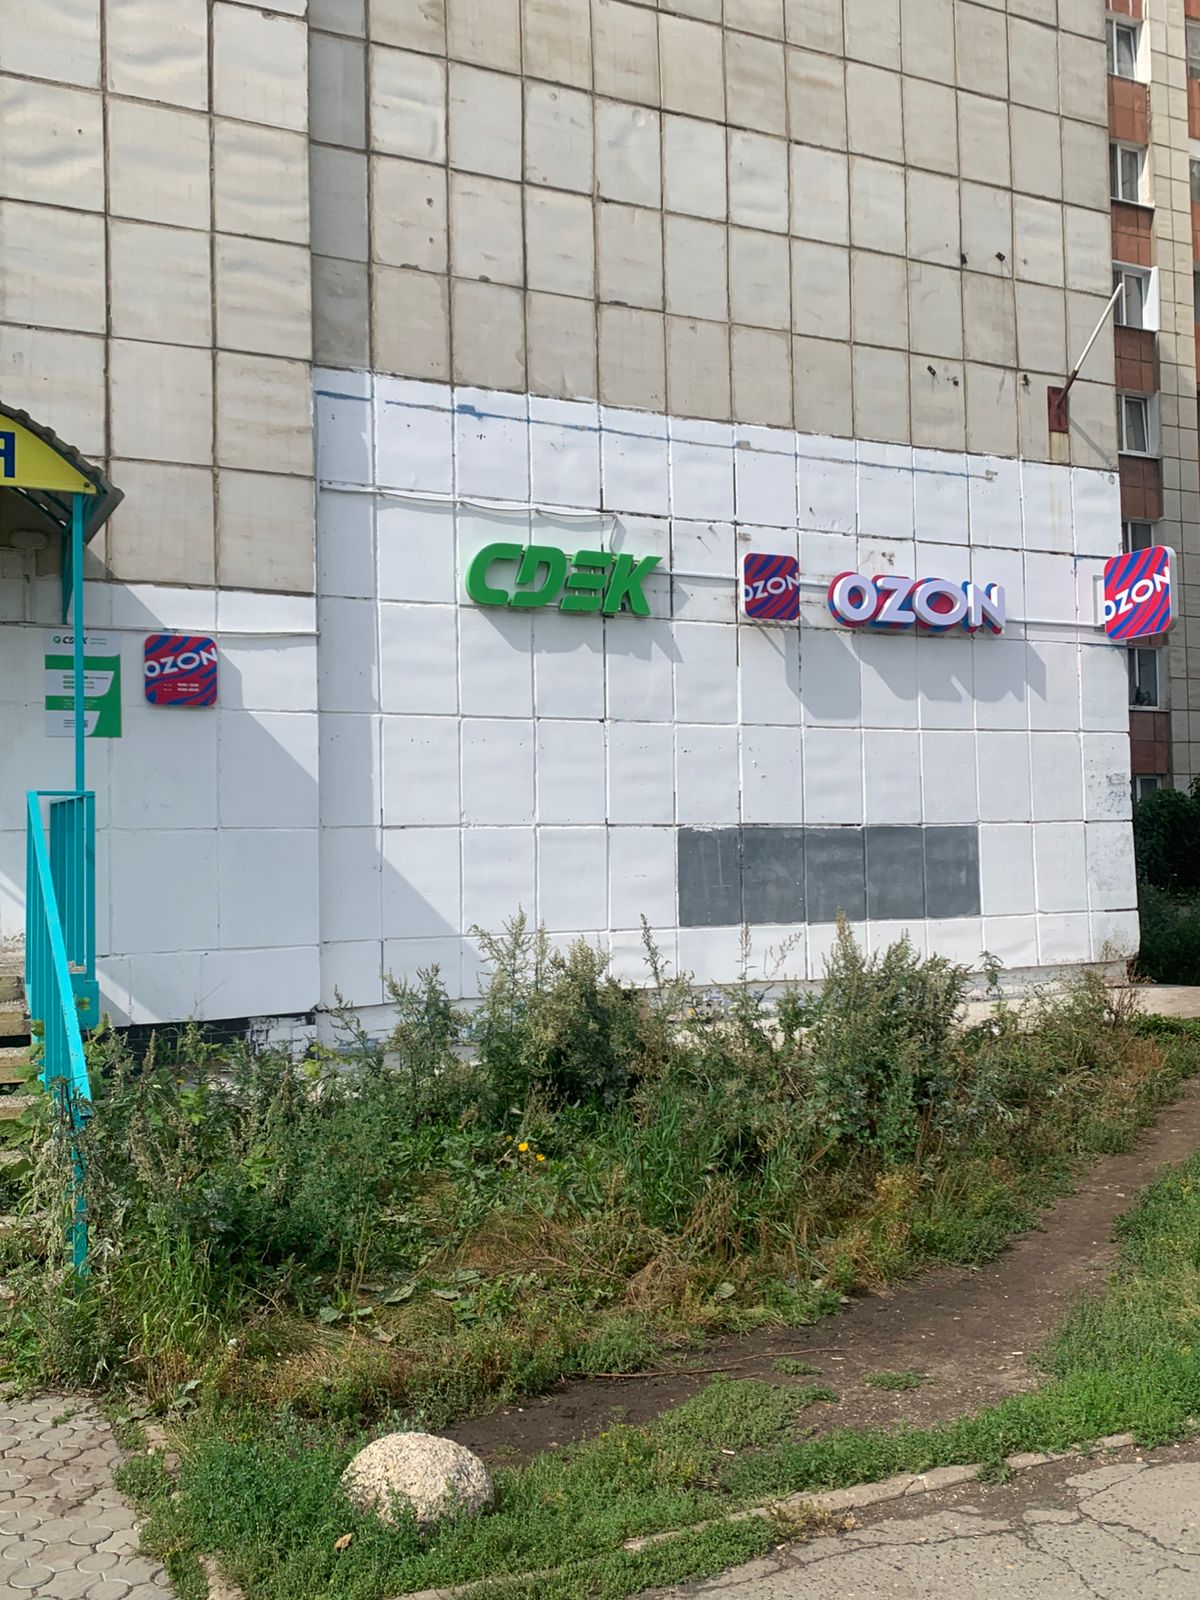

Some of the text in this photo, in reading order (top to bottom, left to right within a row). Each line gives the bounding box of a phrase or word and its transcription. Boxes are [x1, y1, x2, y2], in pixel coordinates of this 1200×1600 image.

[466, 542, 663, 616] CDEK
[829, 572, 1005, 635] OZON
[62, 636, 88, 645] CDK
[144, 647, 218, 678] OZON
